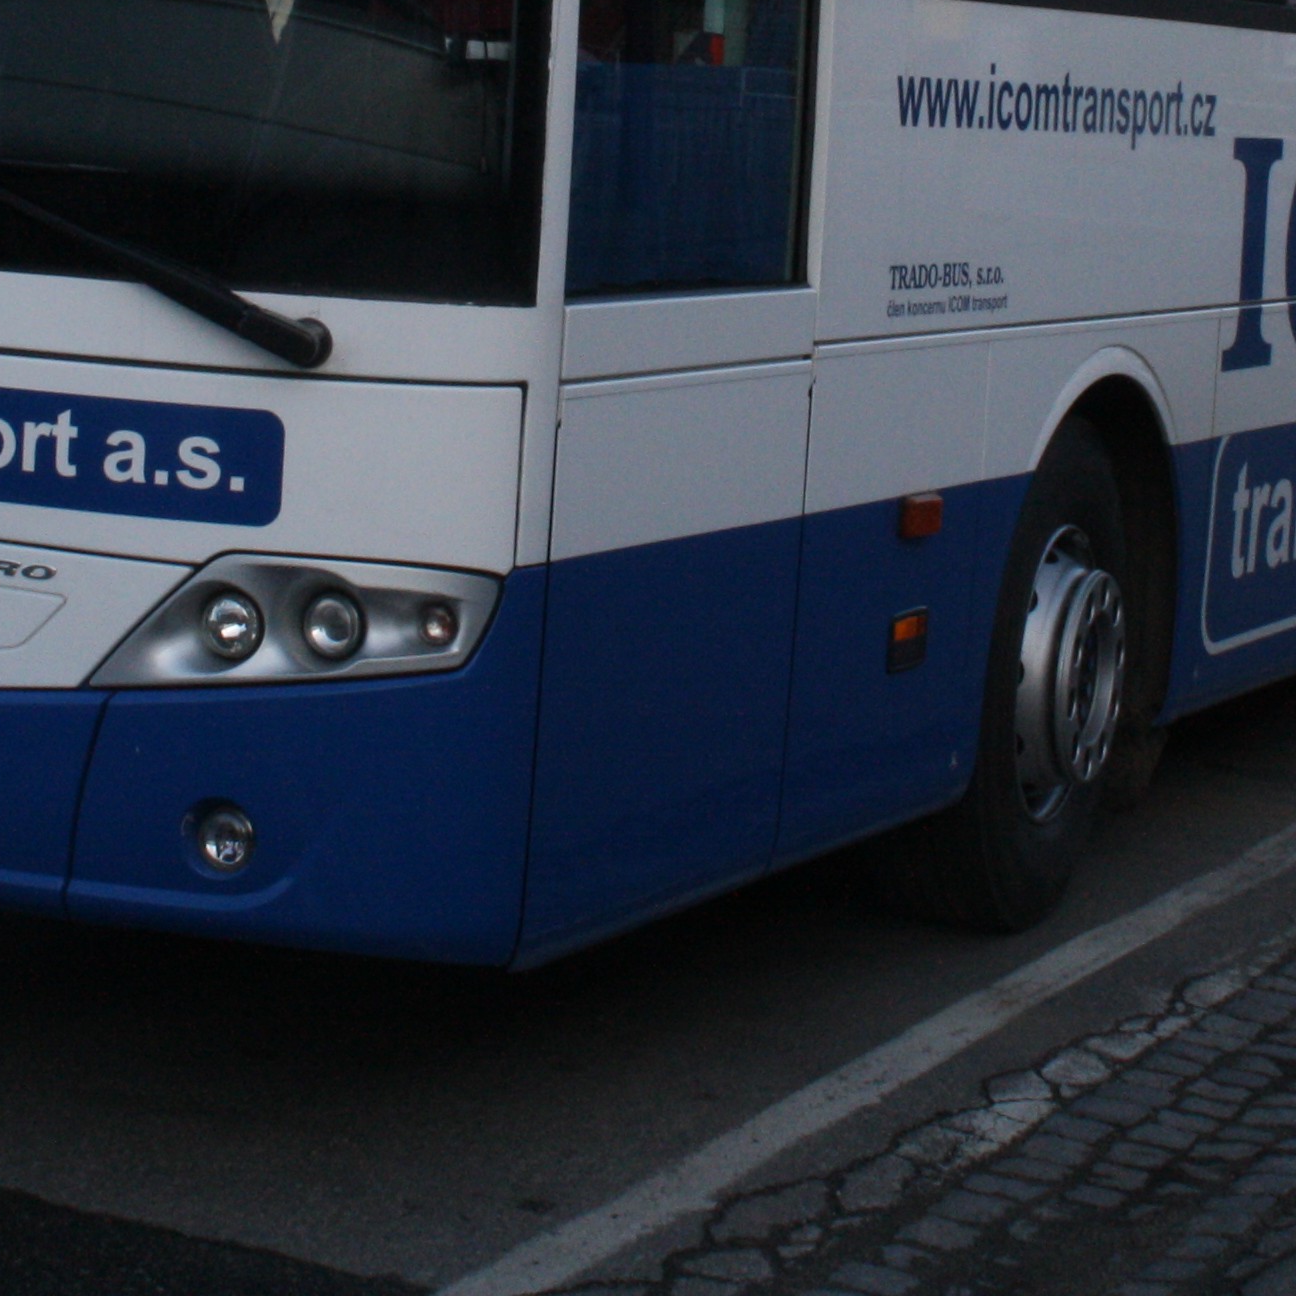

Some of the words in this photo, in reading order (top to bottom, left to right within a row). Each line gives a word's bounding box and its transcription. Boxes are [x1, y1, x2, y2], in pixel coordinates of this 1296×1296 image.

[897, 63, 1217, 150] www.icomtransport.cz
[890, 262, 972, 291] TRADO-BUS,
[976, 266, 1004, 285] s.r.o.
[104, 433, 246, 492] a.s.
